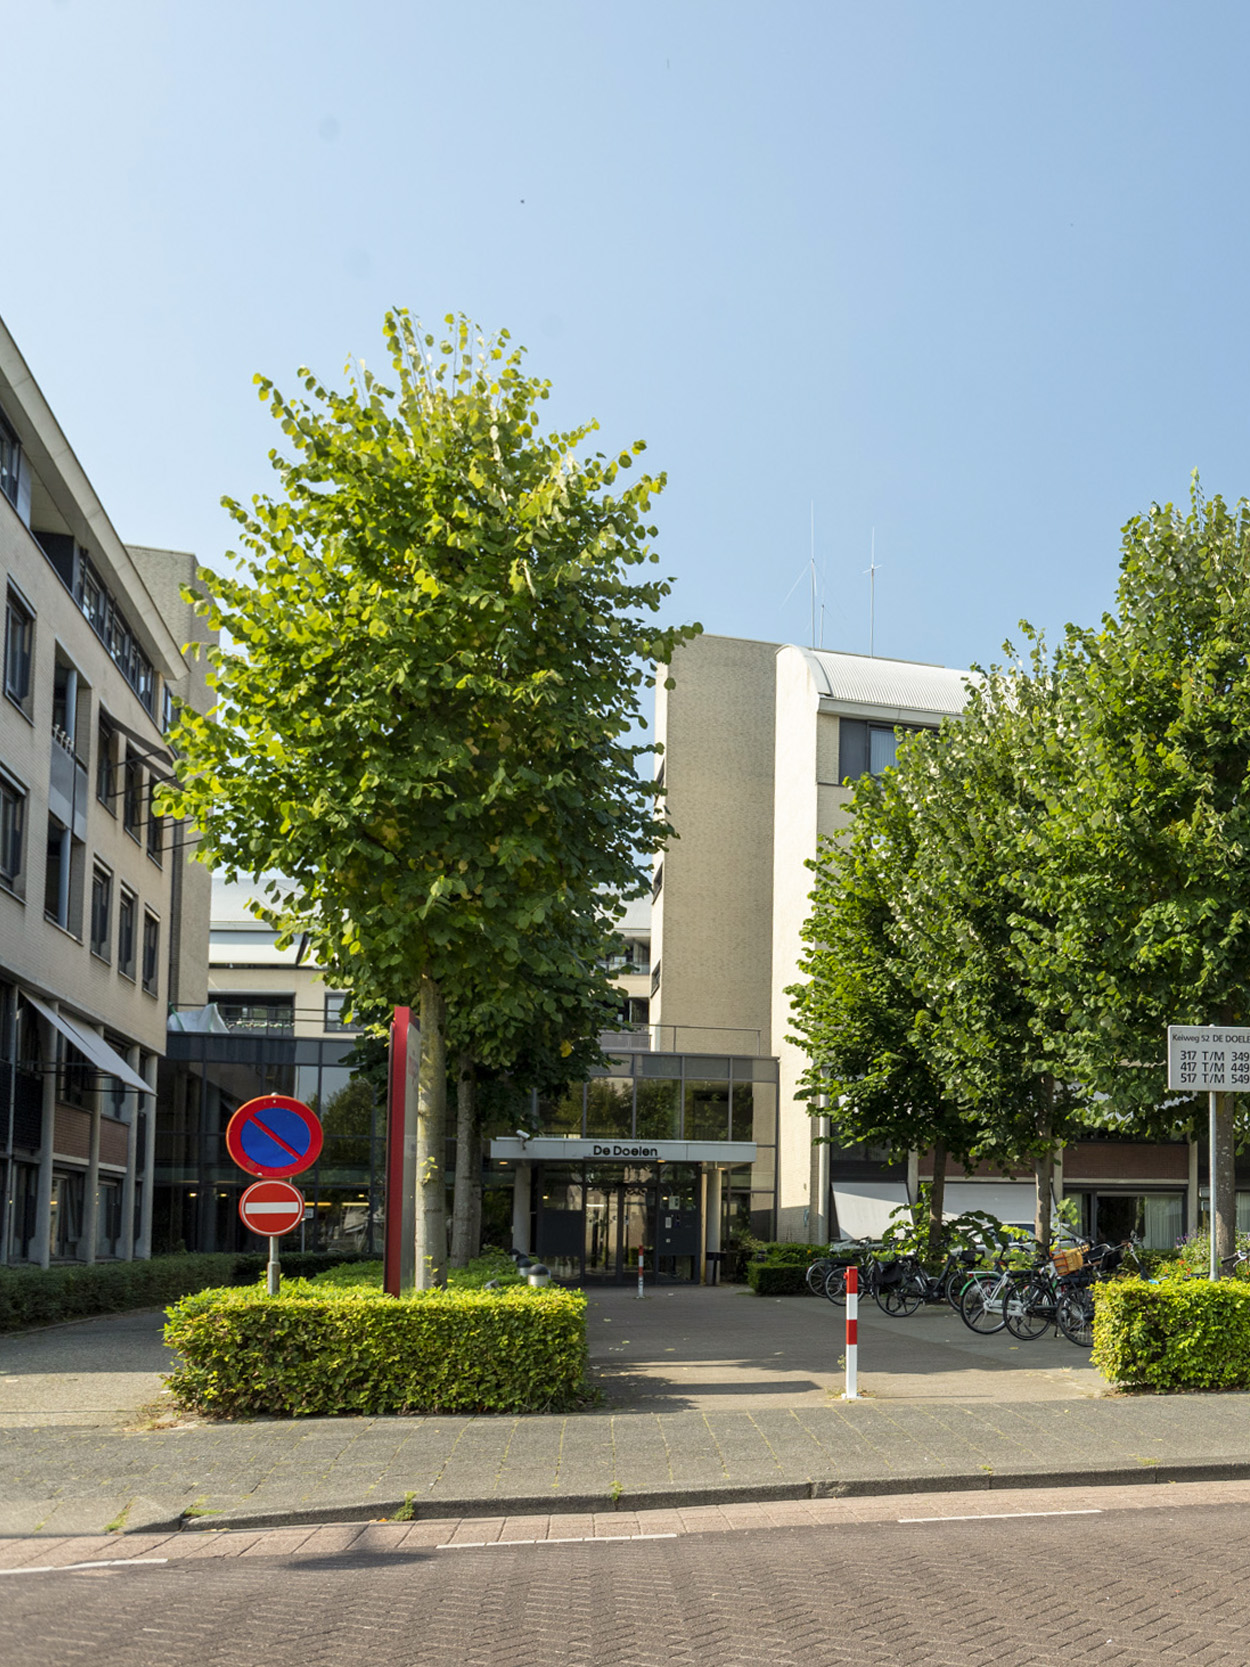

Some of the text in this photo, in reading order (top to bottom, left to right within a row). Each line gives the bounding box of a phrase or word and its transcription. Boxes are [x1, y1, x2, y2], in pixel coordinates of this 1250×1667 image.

[1212, 1034, 1224, 1042] DE
[1180, 1050, 1250, 1062] 317 T/M 349
[1180, 1061, 1250, 1073] 417 T/M 449
[1180, 1073, 1250, 1084] 517 T/M 549
[593, 1144, 658, 1156] De Doelen
